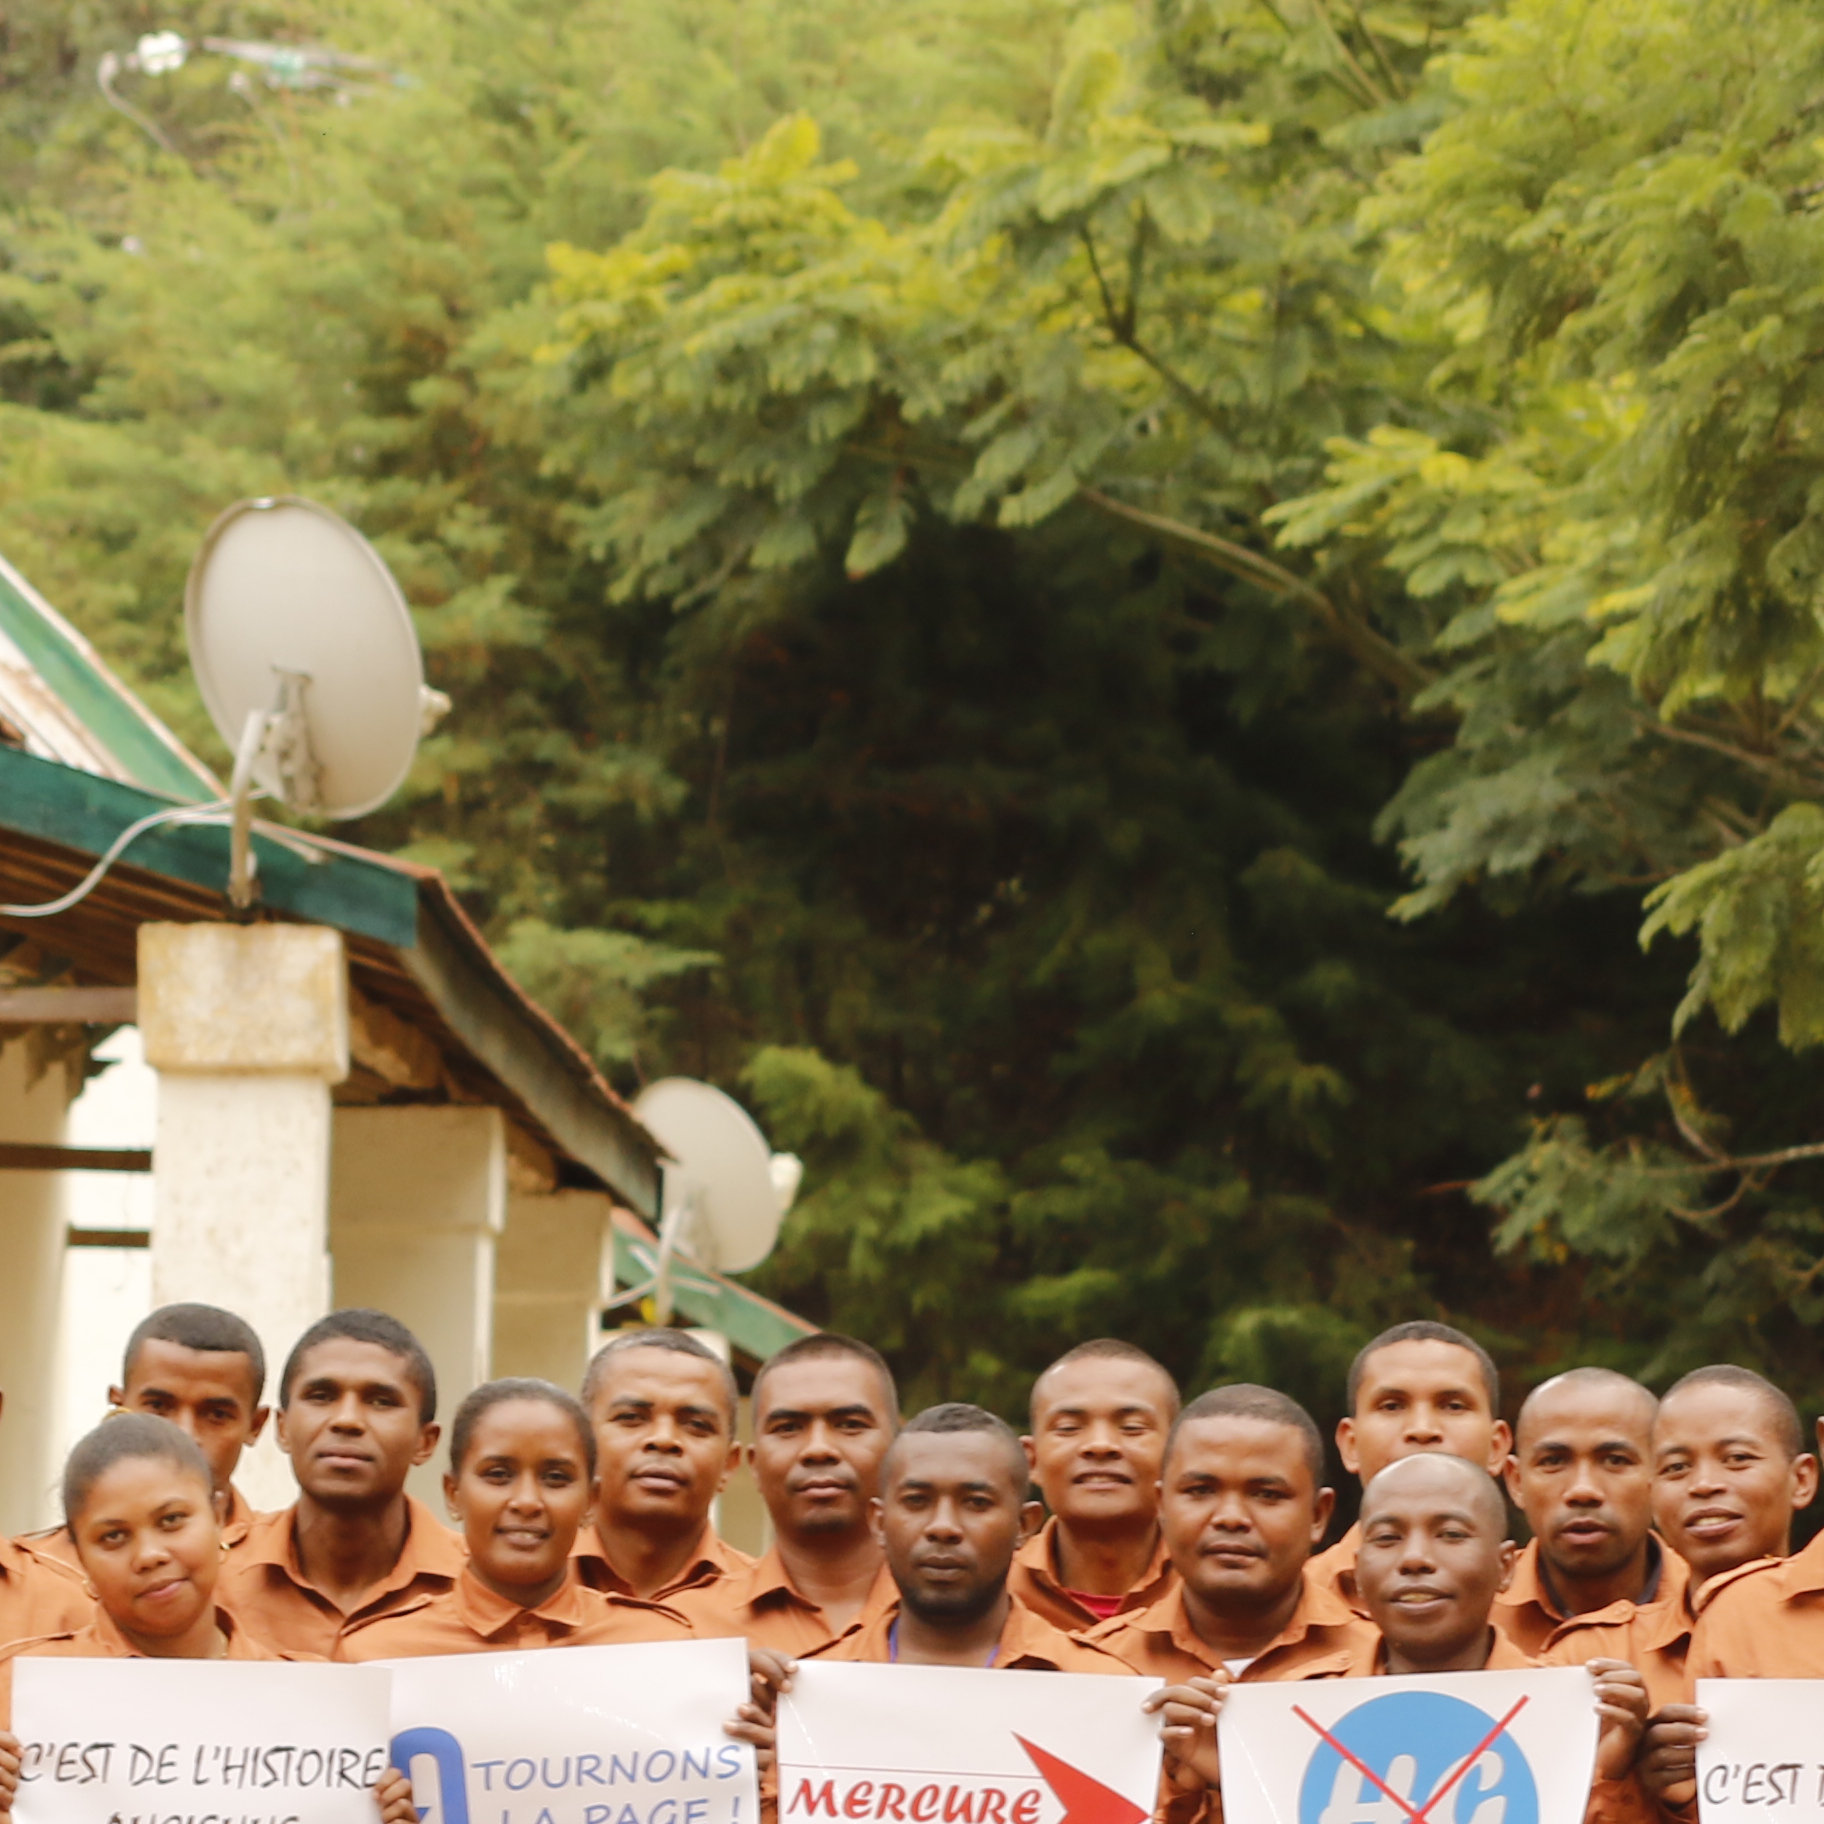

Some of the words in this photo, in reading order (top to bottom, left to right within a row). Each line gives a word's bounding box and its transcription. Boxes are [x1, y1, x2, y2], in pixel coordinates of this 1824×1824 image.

[18, 1742, 116, 1785] C'EST
[129, 1743, 179, 1786] DE
[193, 1745, 385, 1791] L'HISTOIRE
[472, 1744, 743, 1791] TOURNONS
[1703, 1762, 1804, 1807] C'EST
